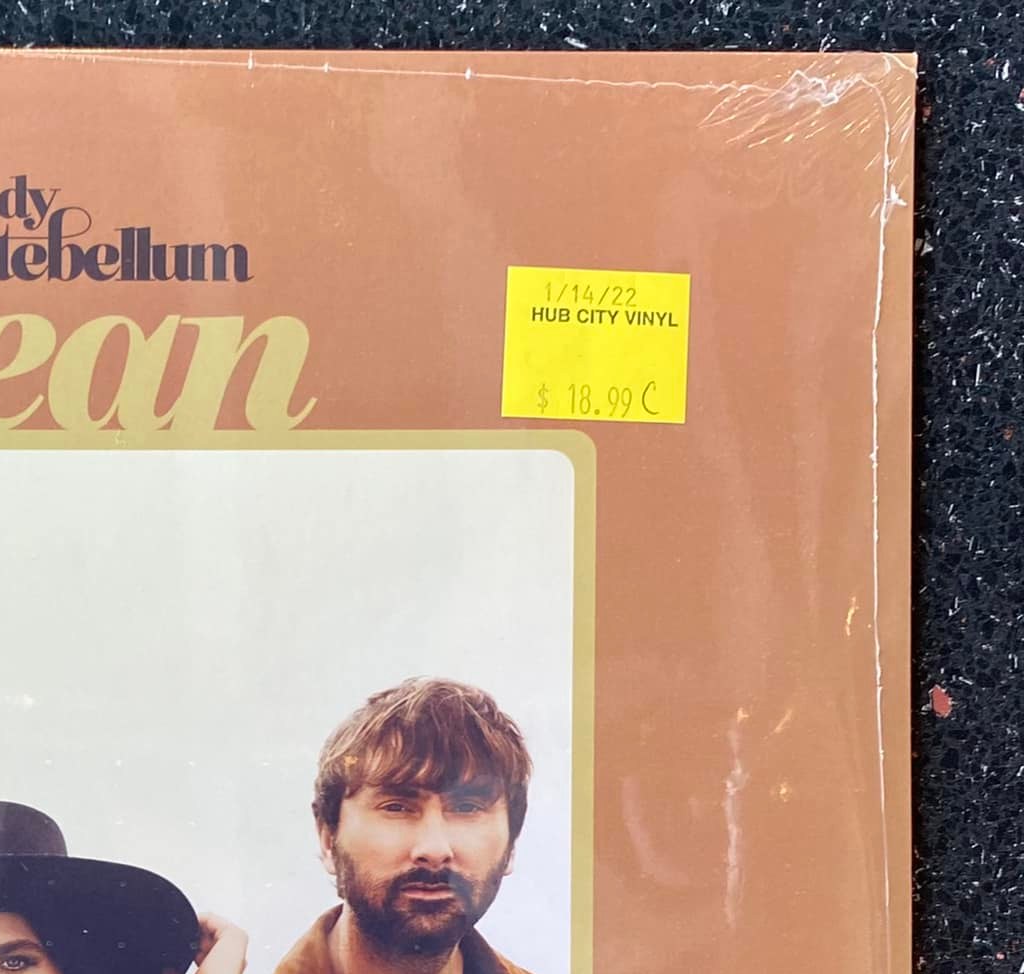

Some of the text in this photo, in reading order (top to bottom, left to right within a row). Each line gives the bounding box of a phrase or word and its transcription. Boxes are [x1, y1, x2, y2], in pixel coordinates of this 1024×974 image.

[544, 282, 637, 308] 1/14/22
[531, 307, 679, 327] HUB CITY VINYL
